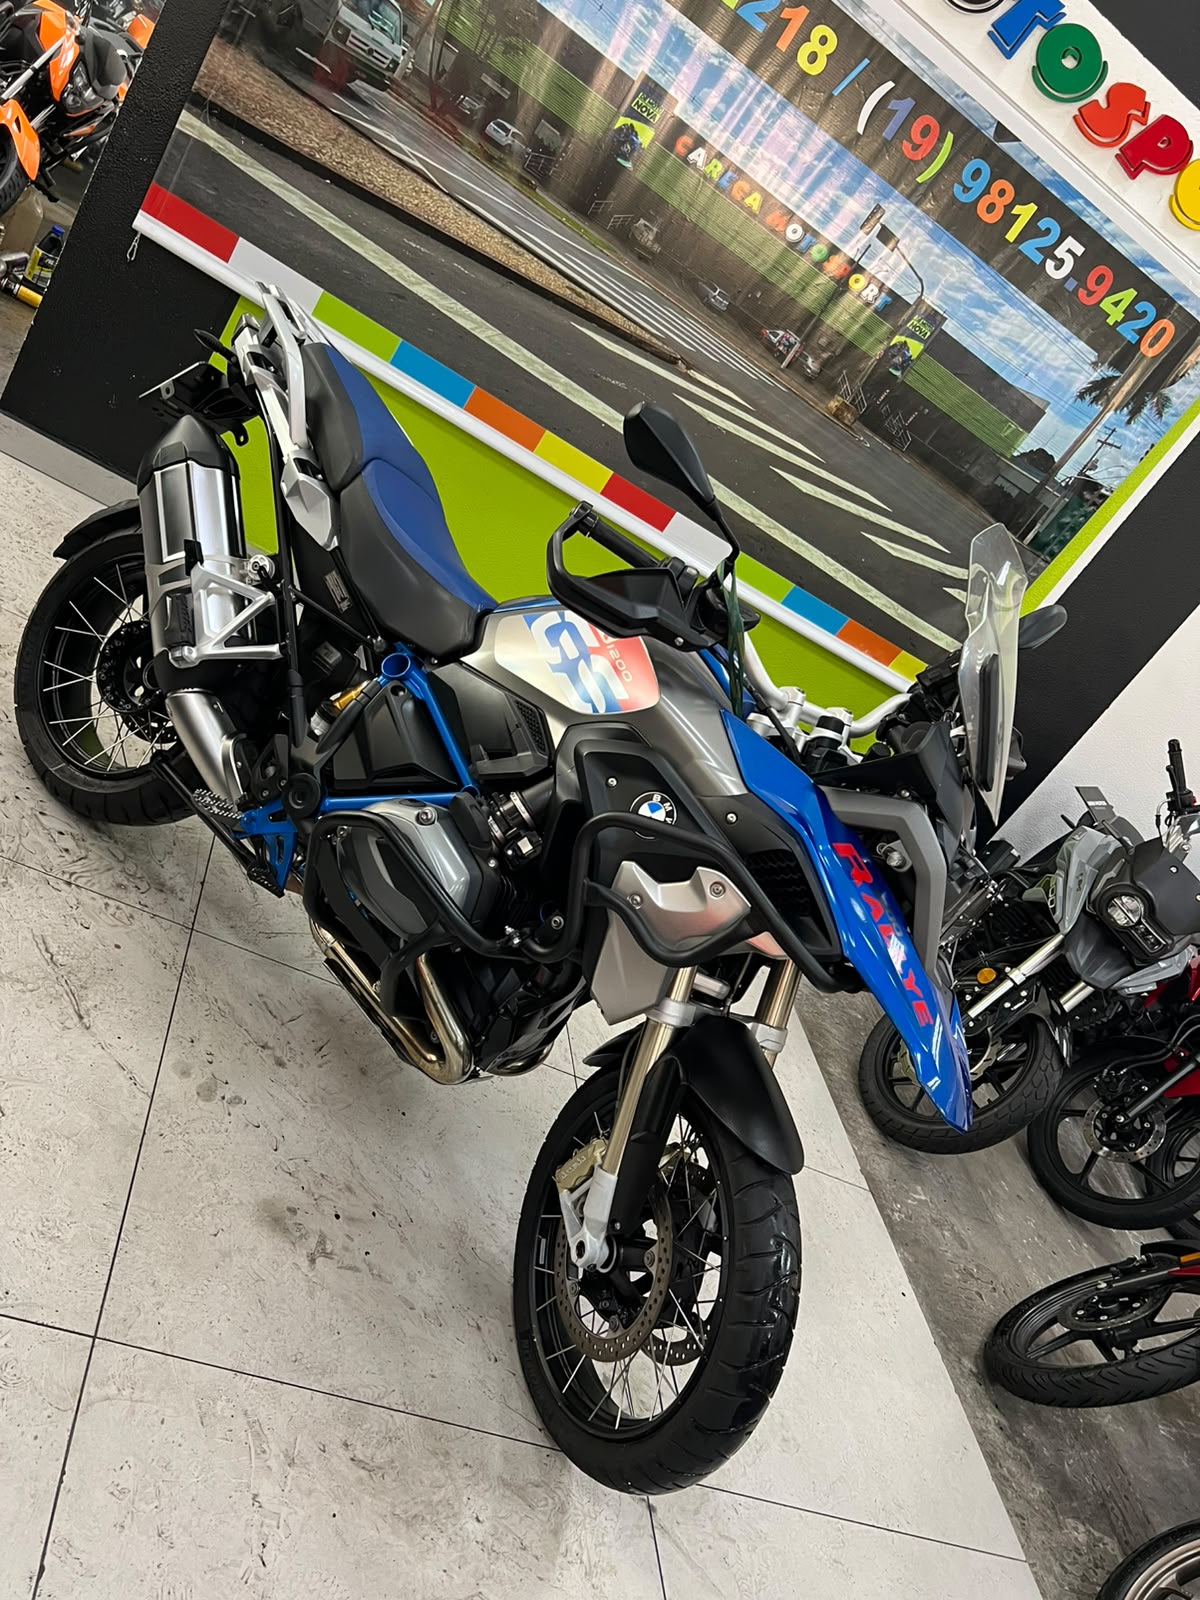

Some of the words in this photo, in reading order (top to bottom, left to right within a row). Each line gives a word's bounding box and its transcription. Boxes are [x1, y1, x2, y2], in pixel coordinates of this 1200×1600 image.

[632, 99, 659, 123] NOVA
[857, 80, 954, 183] (19)
[953, 158, 1176, 358] 98125.9420
